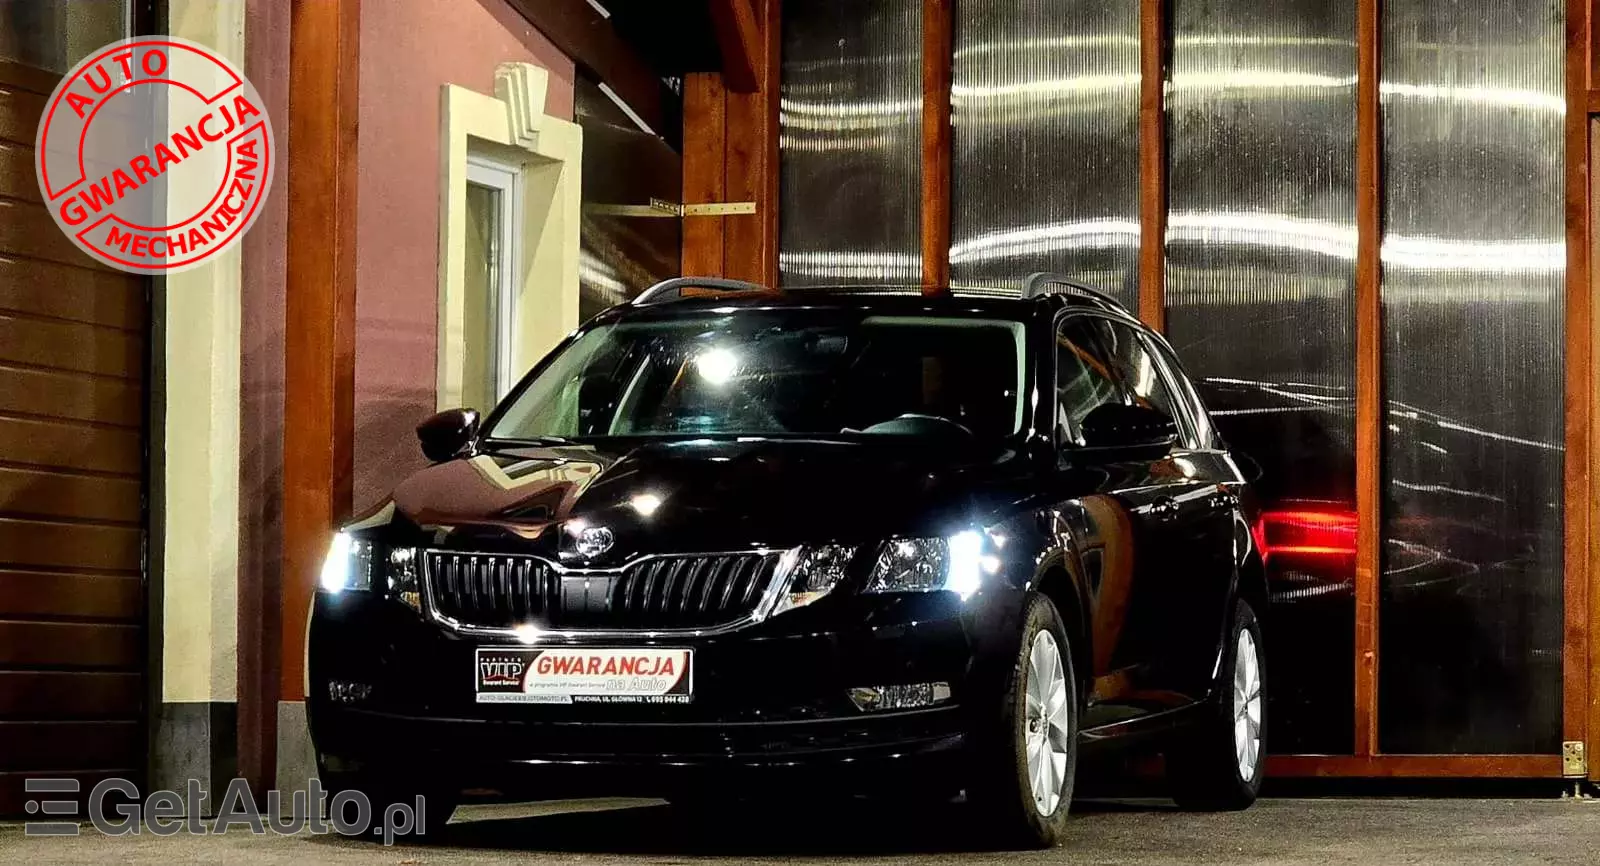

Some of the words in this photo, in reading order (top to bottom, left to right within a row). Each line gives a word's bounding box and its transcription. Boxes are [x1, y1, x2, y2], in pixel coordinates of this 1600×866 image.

[480, 662, 522, 680] VIP
[537, 655, 675, 675] GWARANCJA
[606, 679, 626, 691] na
[627, 677, 667, 691] Auto
